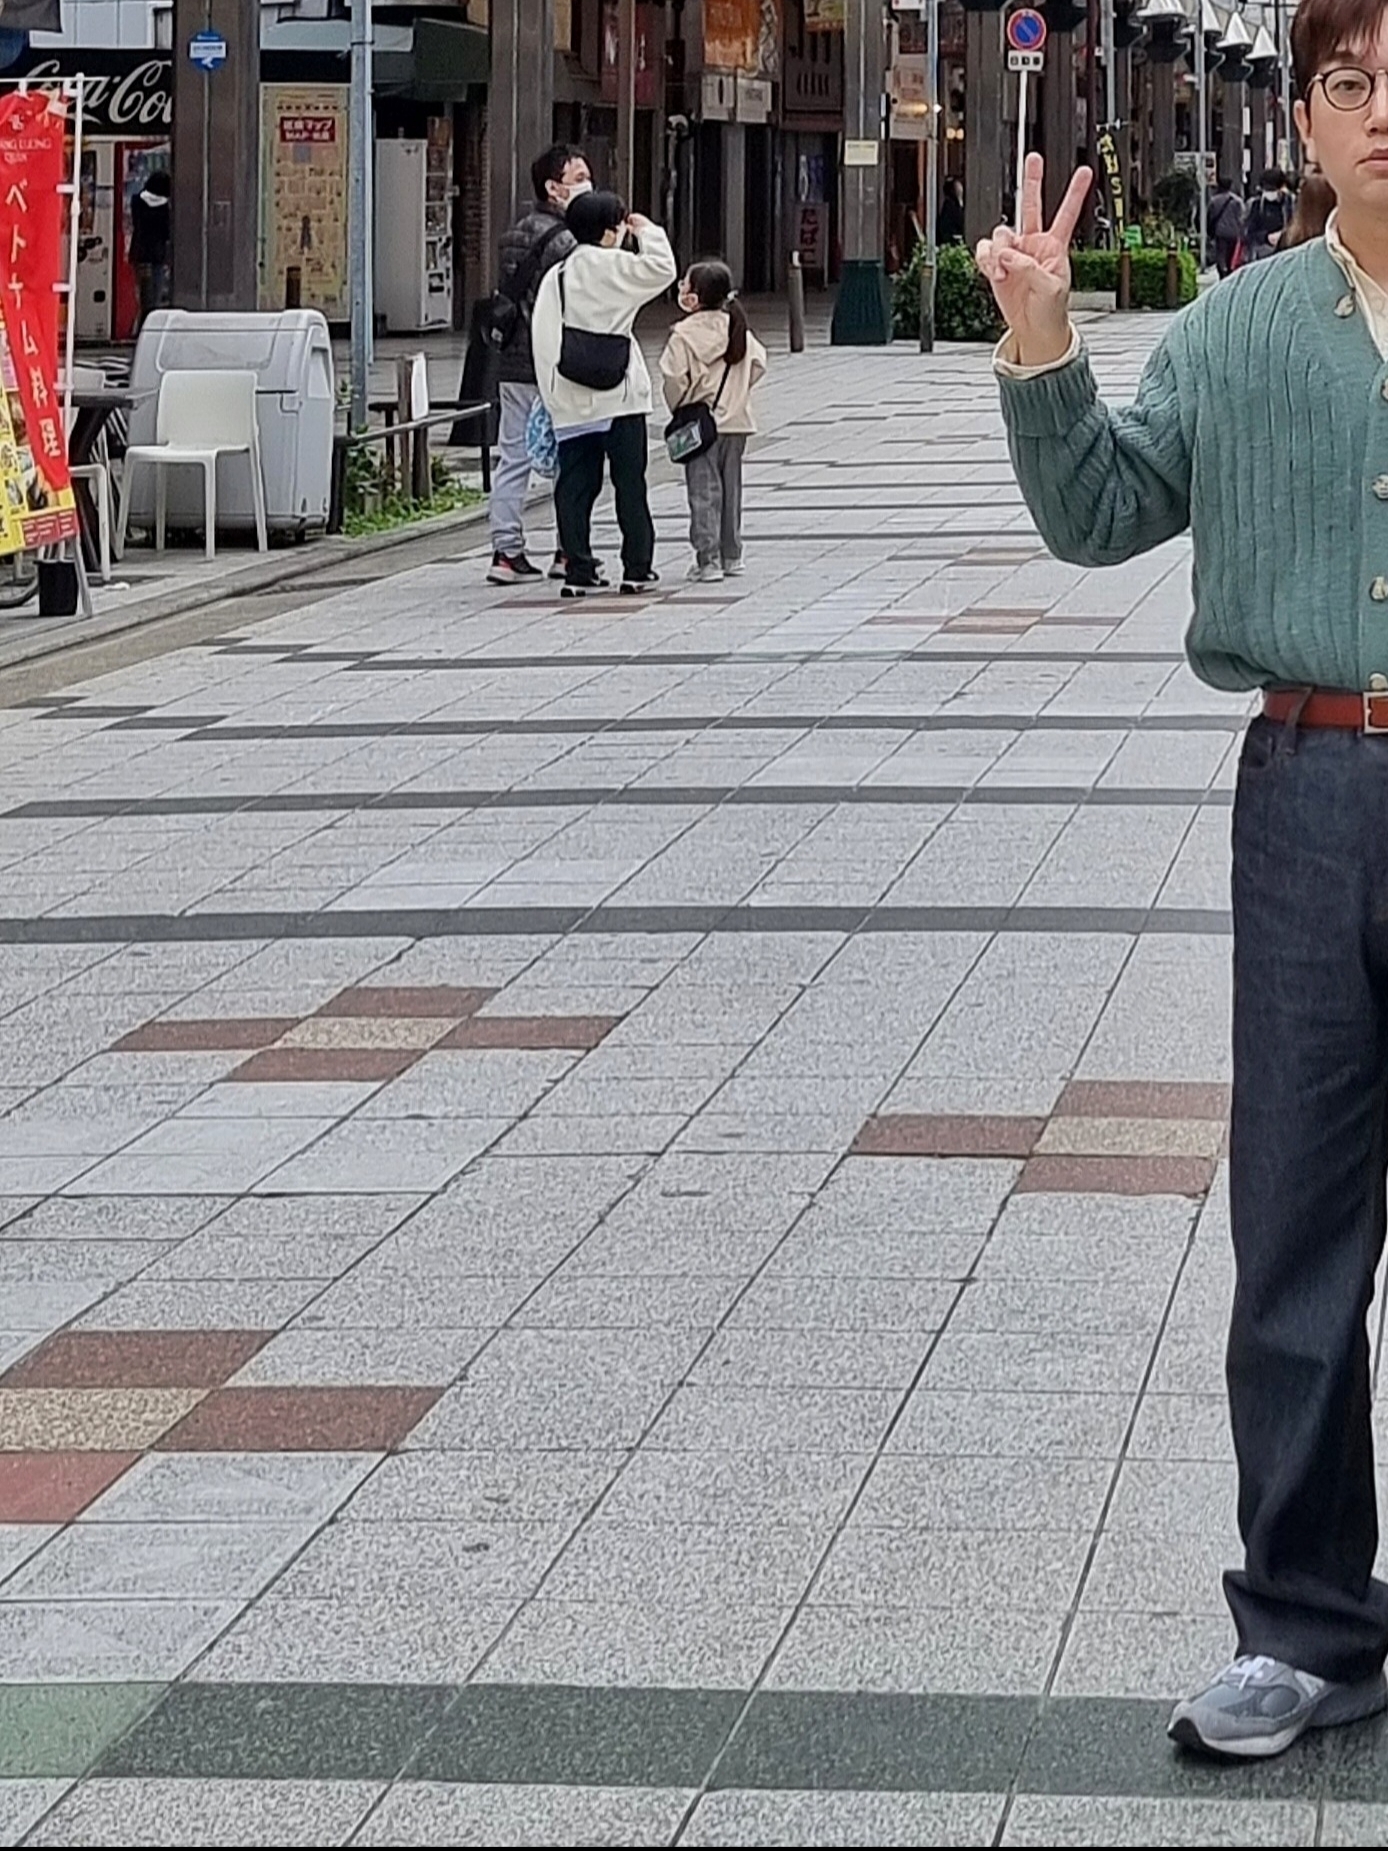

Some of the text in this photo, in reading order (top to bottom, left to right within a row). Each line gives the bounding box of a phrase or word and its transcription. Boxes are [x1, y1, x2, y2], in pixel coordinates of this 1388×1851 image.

[5, 178, 62, 459] ベトナム料理
